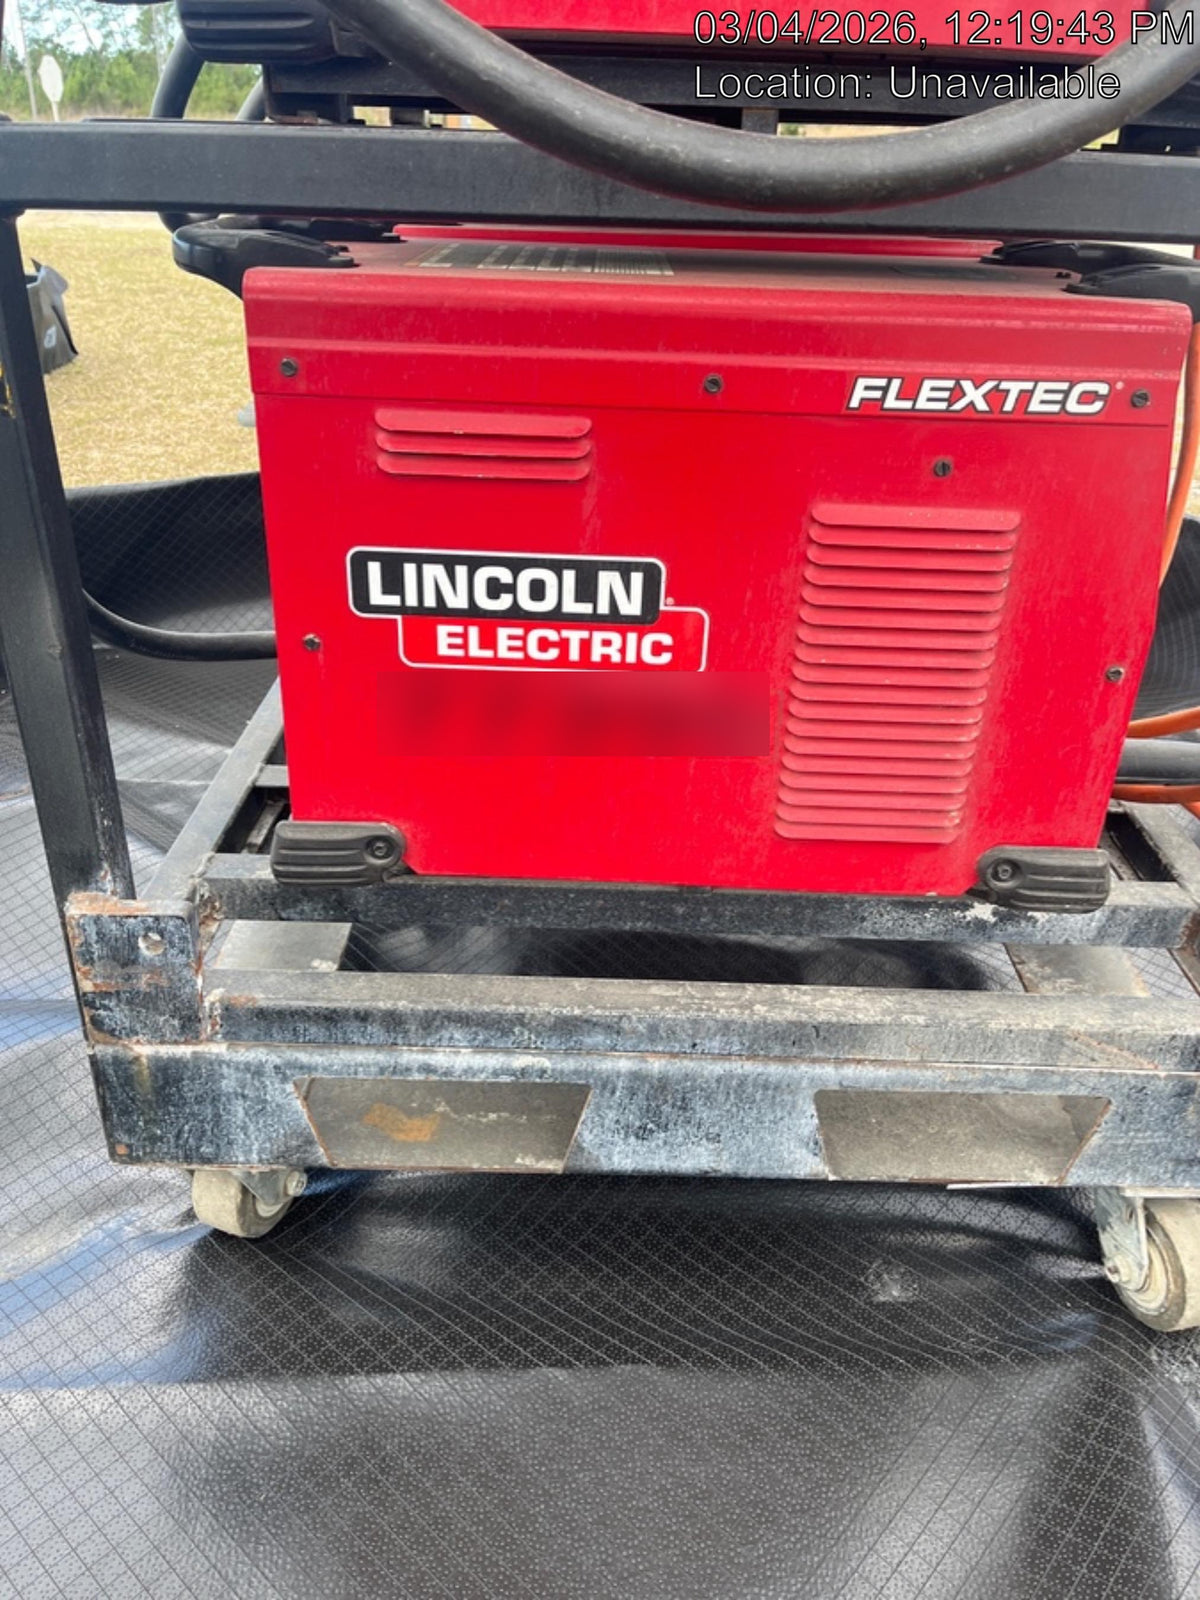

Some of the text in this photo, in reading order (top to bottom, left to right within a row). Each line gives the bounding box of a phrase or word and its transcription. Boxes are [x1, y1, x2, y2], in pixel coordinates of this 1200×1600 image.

[846, 376, 1111, 415] FLEXTEC
[366, 561, 644, 617] LINCOLN
[435, 624, 674, 665] ELECTRIC
